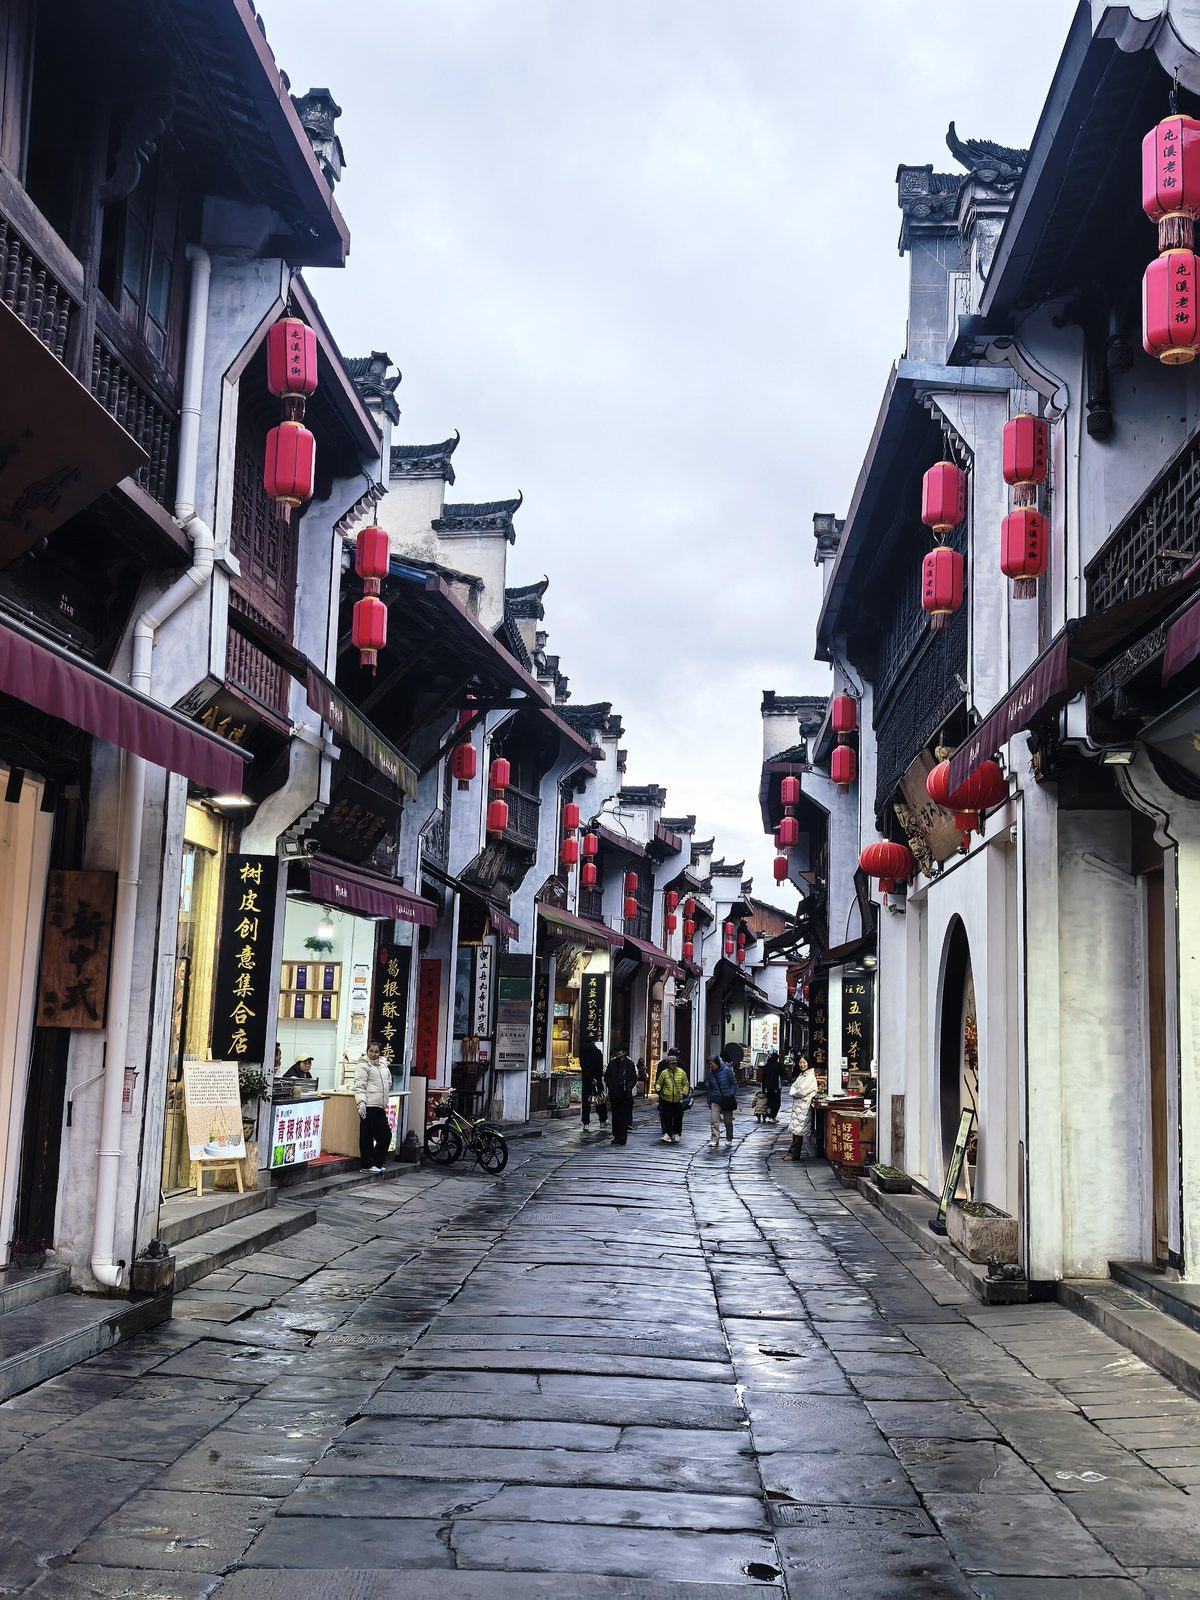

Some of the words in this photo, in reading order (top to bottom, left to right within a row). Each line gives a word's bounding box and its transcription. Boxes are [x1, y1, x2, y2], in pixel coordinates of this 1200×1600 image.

[1162, 129, 1178, 189] 屯溪老街
[1175, 264, 1191, 324] 屯溪老街
[290, 329, 302, 376] 屯溪老街
[227, 862, 263, 1054] 树皮创意集合店
[381, 958, 401, 1063] 葛根酥专卖
[813, 991, 828, 1063] 鼎昌珠宝
[278, 1115, 320, 1143] 青稞核桃饼
[842, 1123, 854, 1161] 好吃再来
